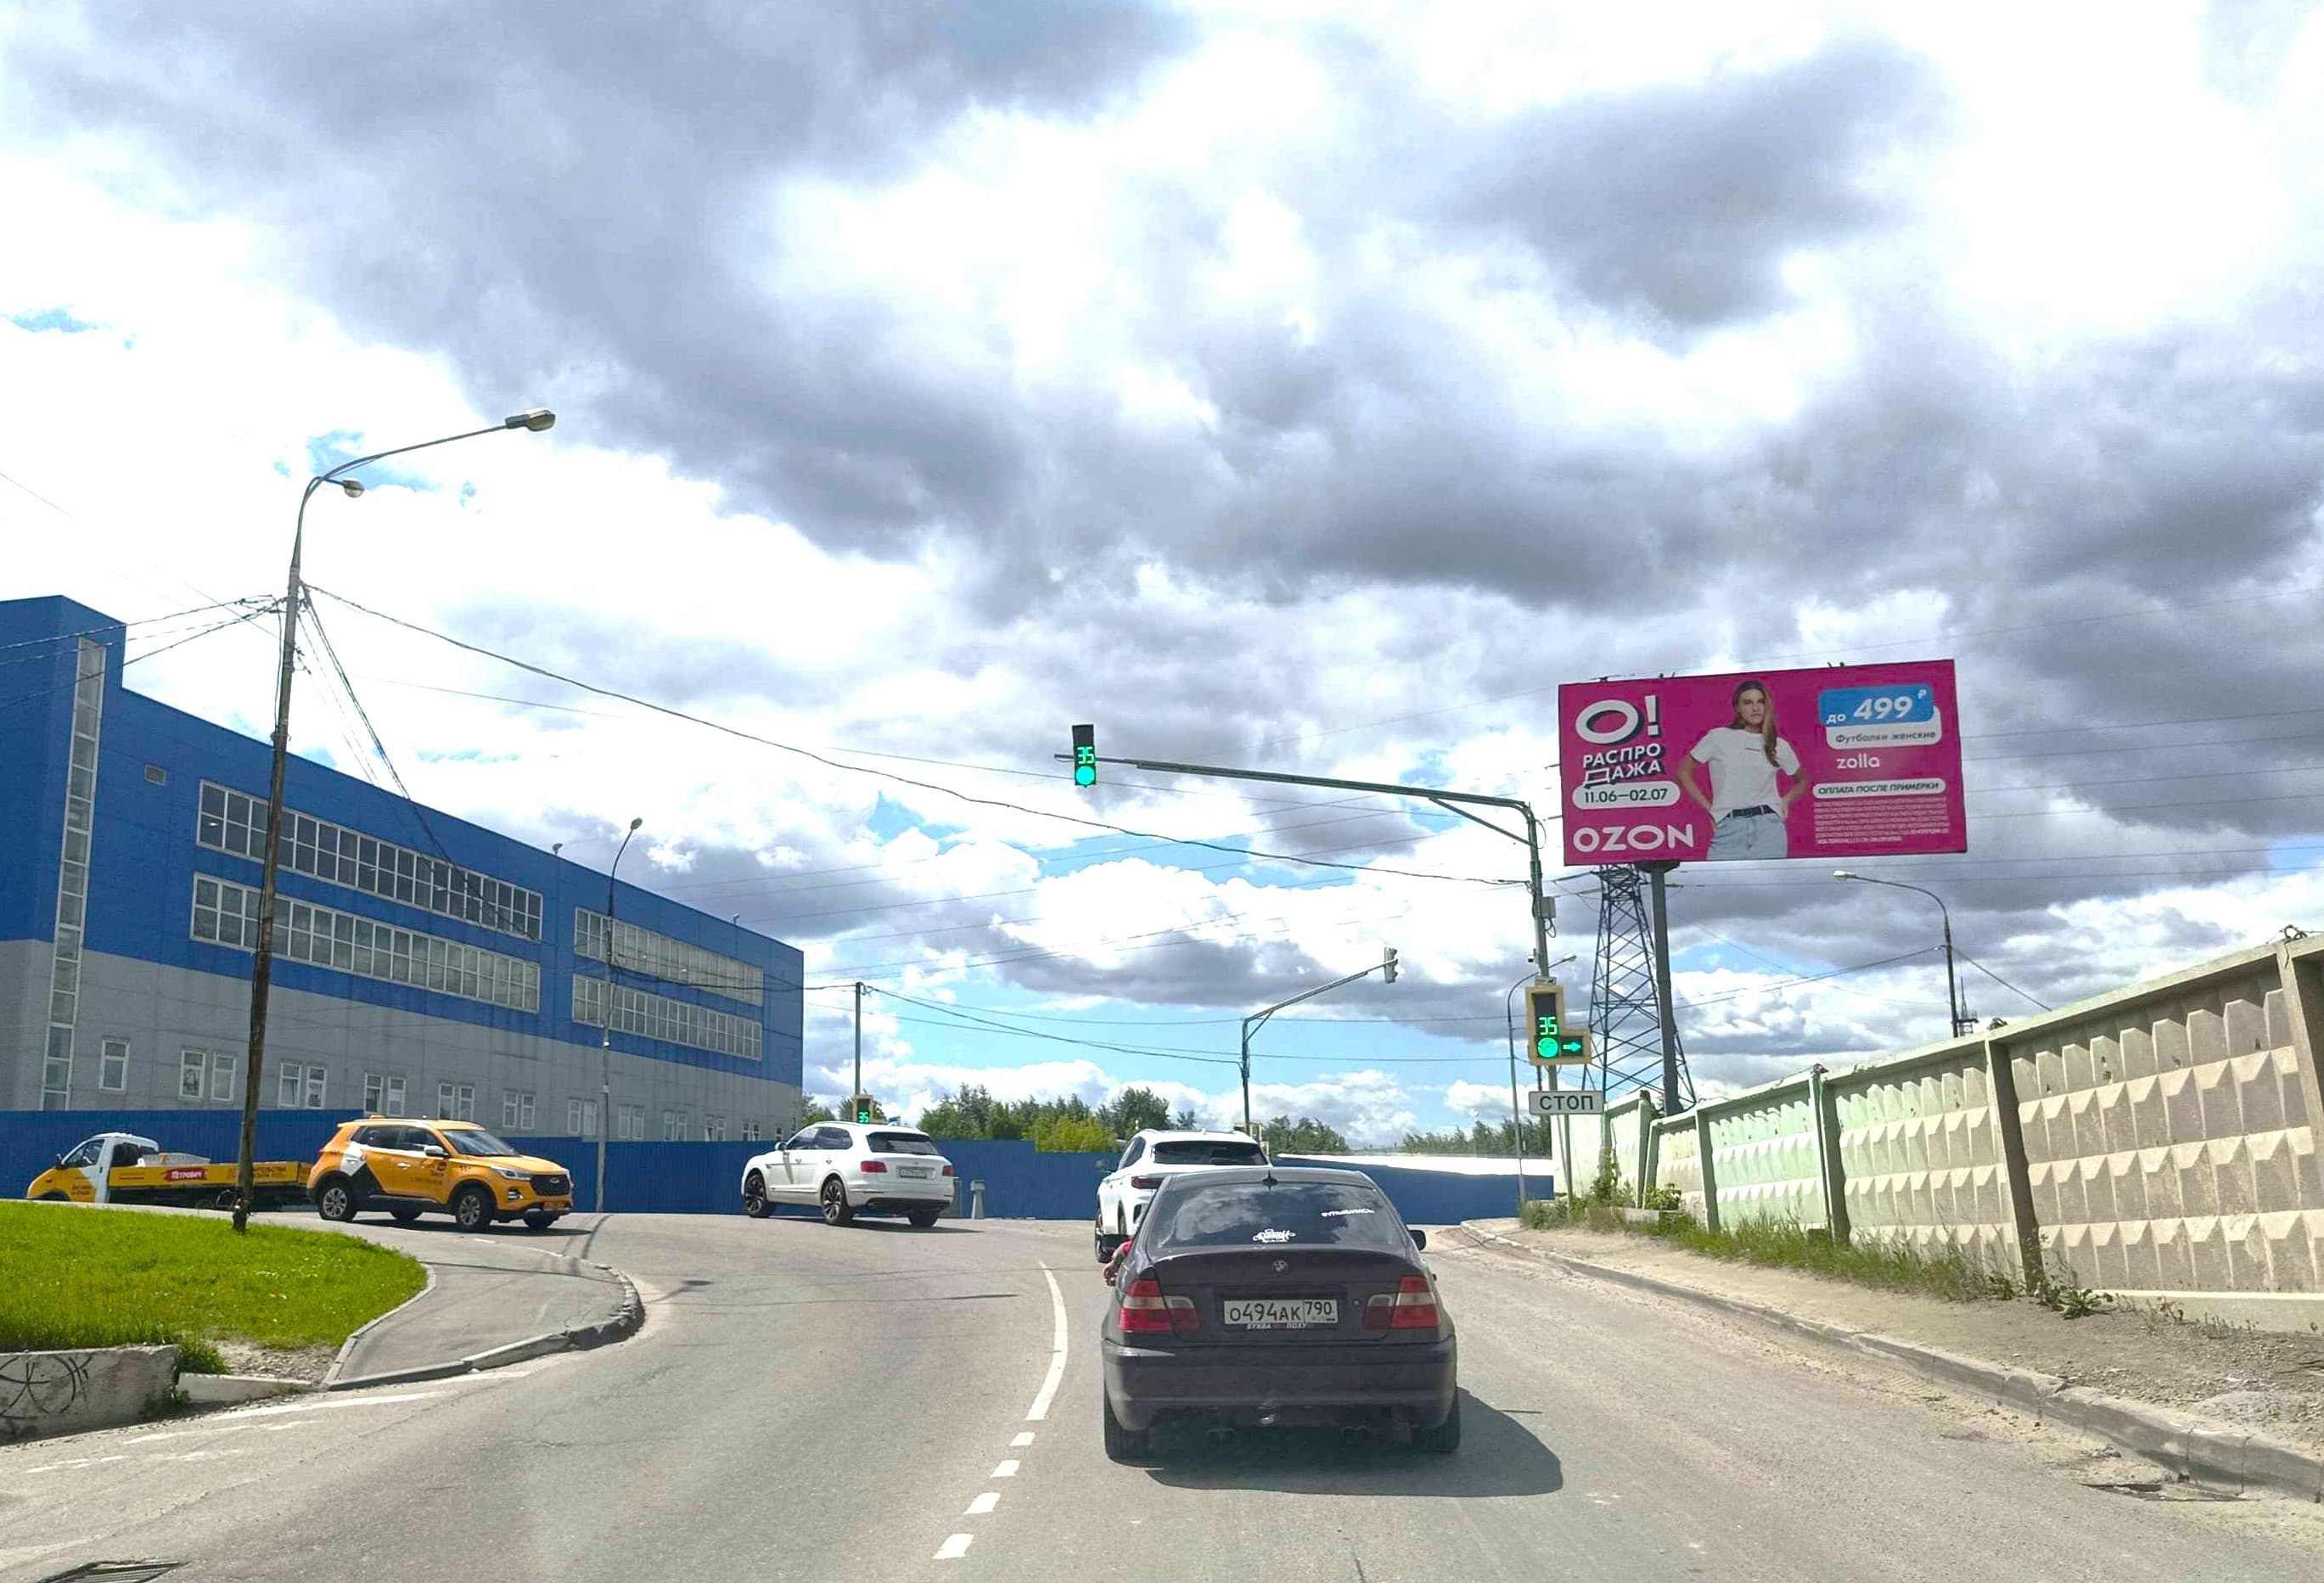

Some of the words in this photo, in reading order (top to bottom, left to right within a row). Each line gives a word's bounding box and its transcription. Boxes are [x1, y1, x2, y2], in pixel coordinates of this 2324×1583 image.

[1575, 695, 1659, 744] О!
[1826, 714, 1846, 724] до
[1854, 696, 1913, 720] 499
[1836, 734, 1888, 744] Футболки
[1891, 732, 1936, 740] женские
[1076, 746, 1095, 764] 35
[1582, 743, 1661, 768] РАСПРО
[1836, 753, 1880, 769] zolla
[1582, 760, 1661, 786] ДАЖА
[1818, 785, 1854, 794] ОПЛАТА
[1856, 783, 1888, 793] ПОСЛЕ
[1889, 782, 1939, 792] ПРИМЕРКИ
[1573, 823, 1694, 852] OZON
[1538, 1016, 1558, 1036] 35
[1540, 1095, 1593, 1110] СТОП
[1305, 1301, 1333, 1315] 790
